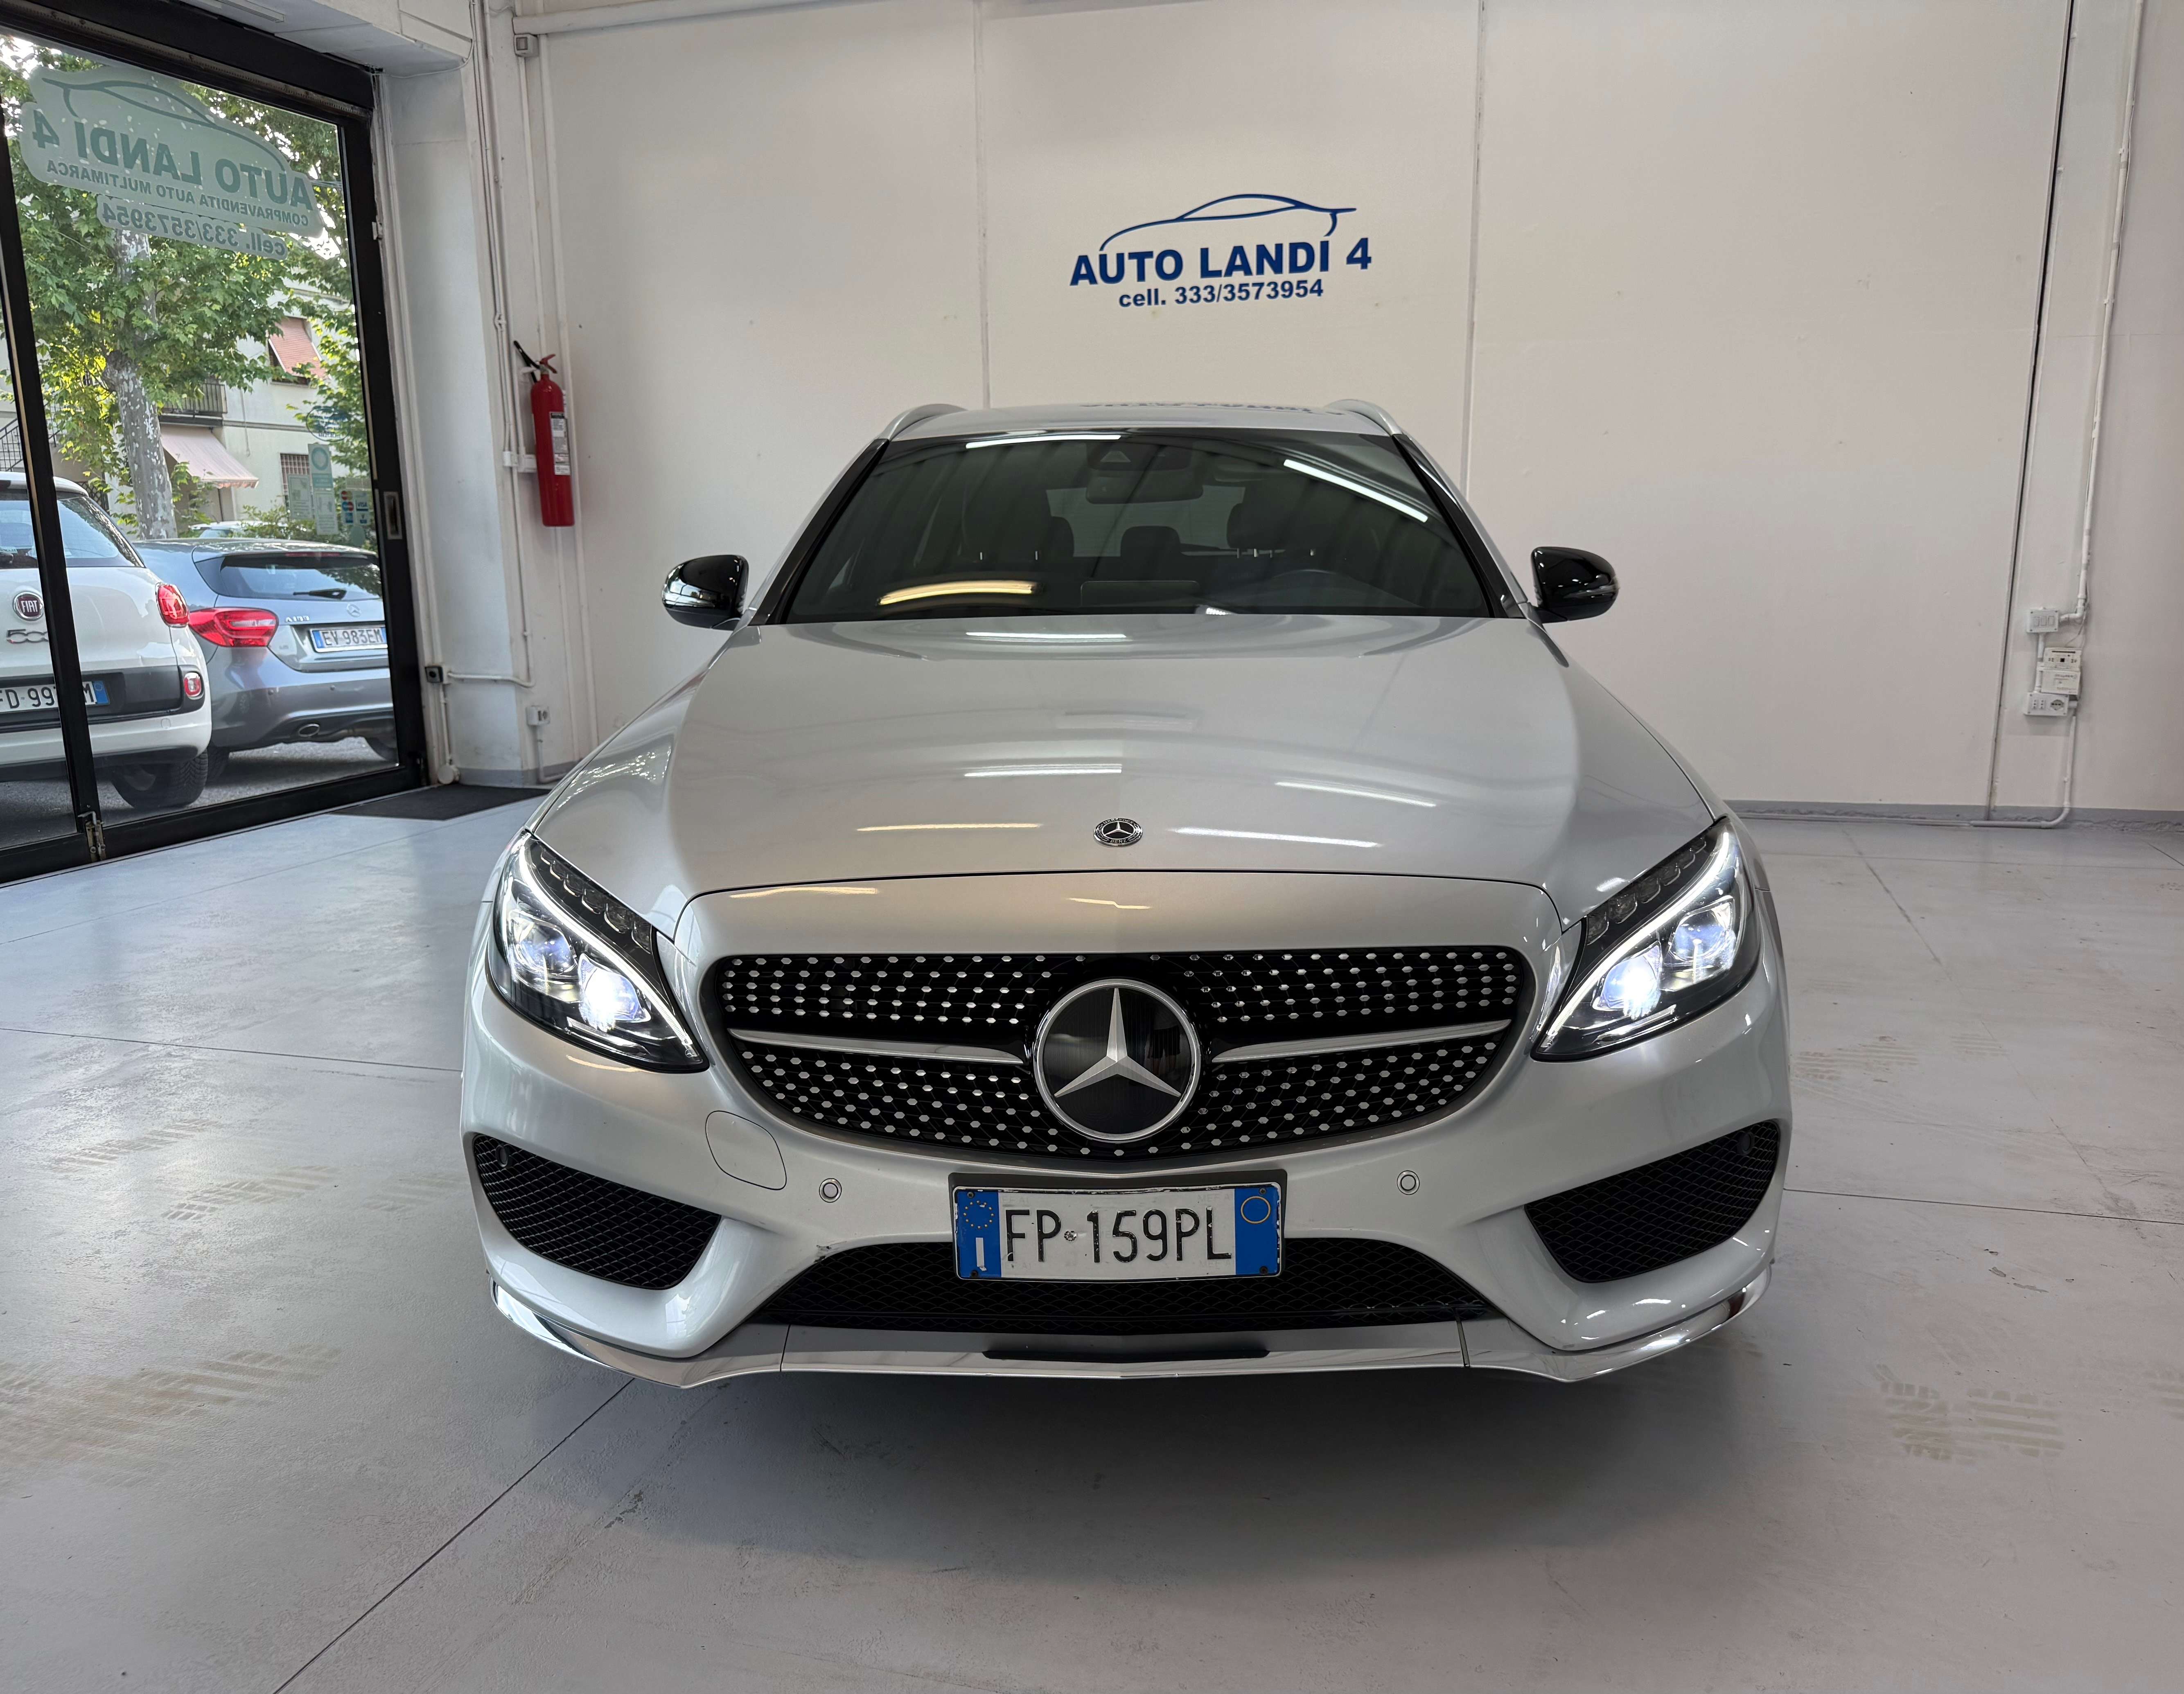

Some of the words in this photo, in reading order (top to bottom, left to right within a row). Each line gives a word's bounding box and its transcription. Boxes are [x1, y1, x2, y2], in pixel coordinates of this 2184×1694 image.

[1069, 249, 1184, 286] AUTO
[1200, 240, 1330, 279] LANDI
[1346, 237, 1372, 270] 4
[1118, 288, 1166, 307] cell.
[1174, 279, 1324, 305] 333/3573954
[20, 600, 38, 613] FIAT
[322, 631, 339, 646] EV
[342, 629, 383, 645] 983EM
[1005, 1209, 1062, 1262] FP
[1087, 1207, 1232, 1263] 159PL
